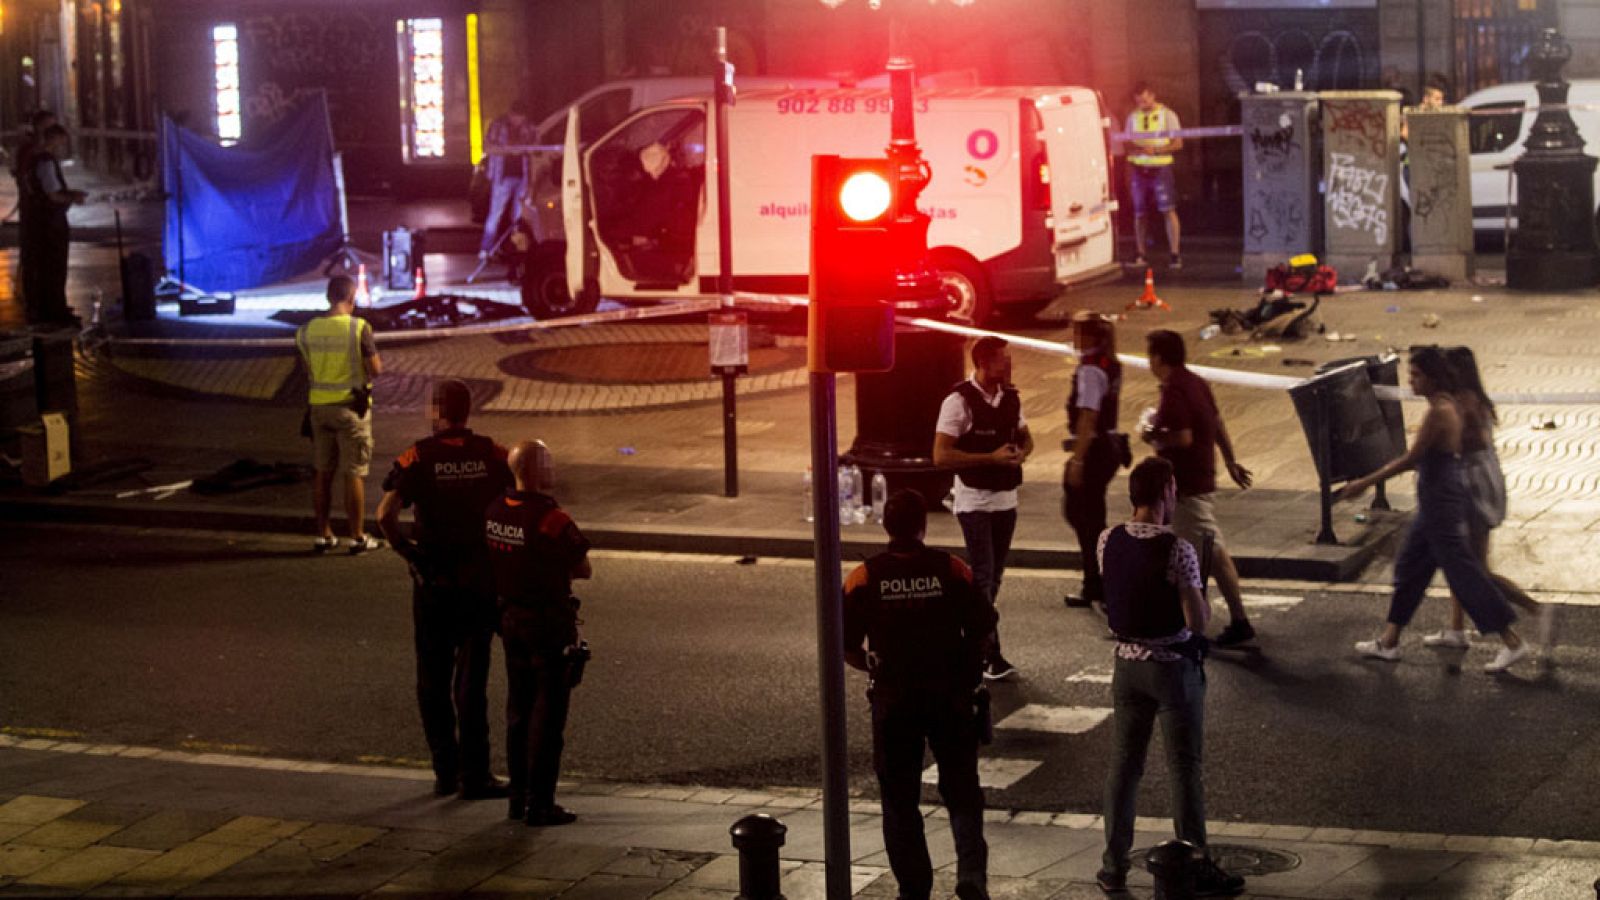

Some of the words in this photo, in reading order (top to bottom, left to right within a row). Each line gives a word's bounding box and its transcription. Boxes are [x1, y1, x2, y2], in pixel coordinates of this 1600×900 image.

[777, 97, 819, 114] 902
[827, 97, 856, 114] 88
[864, 97, 892, 114] 99
[760, 201, 811, 218] alquil
[435, 460, 487, 474] POLICIA
[486, 520, 525, 539] POLICIA
[880, 576, 941, 594] POLICIA
